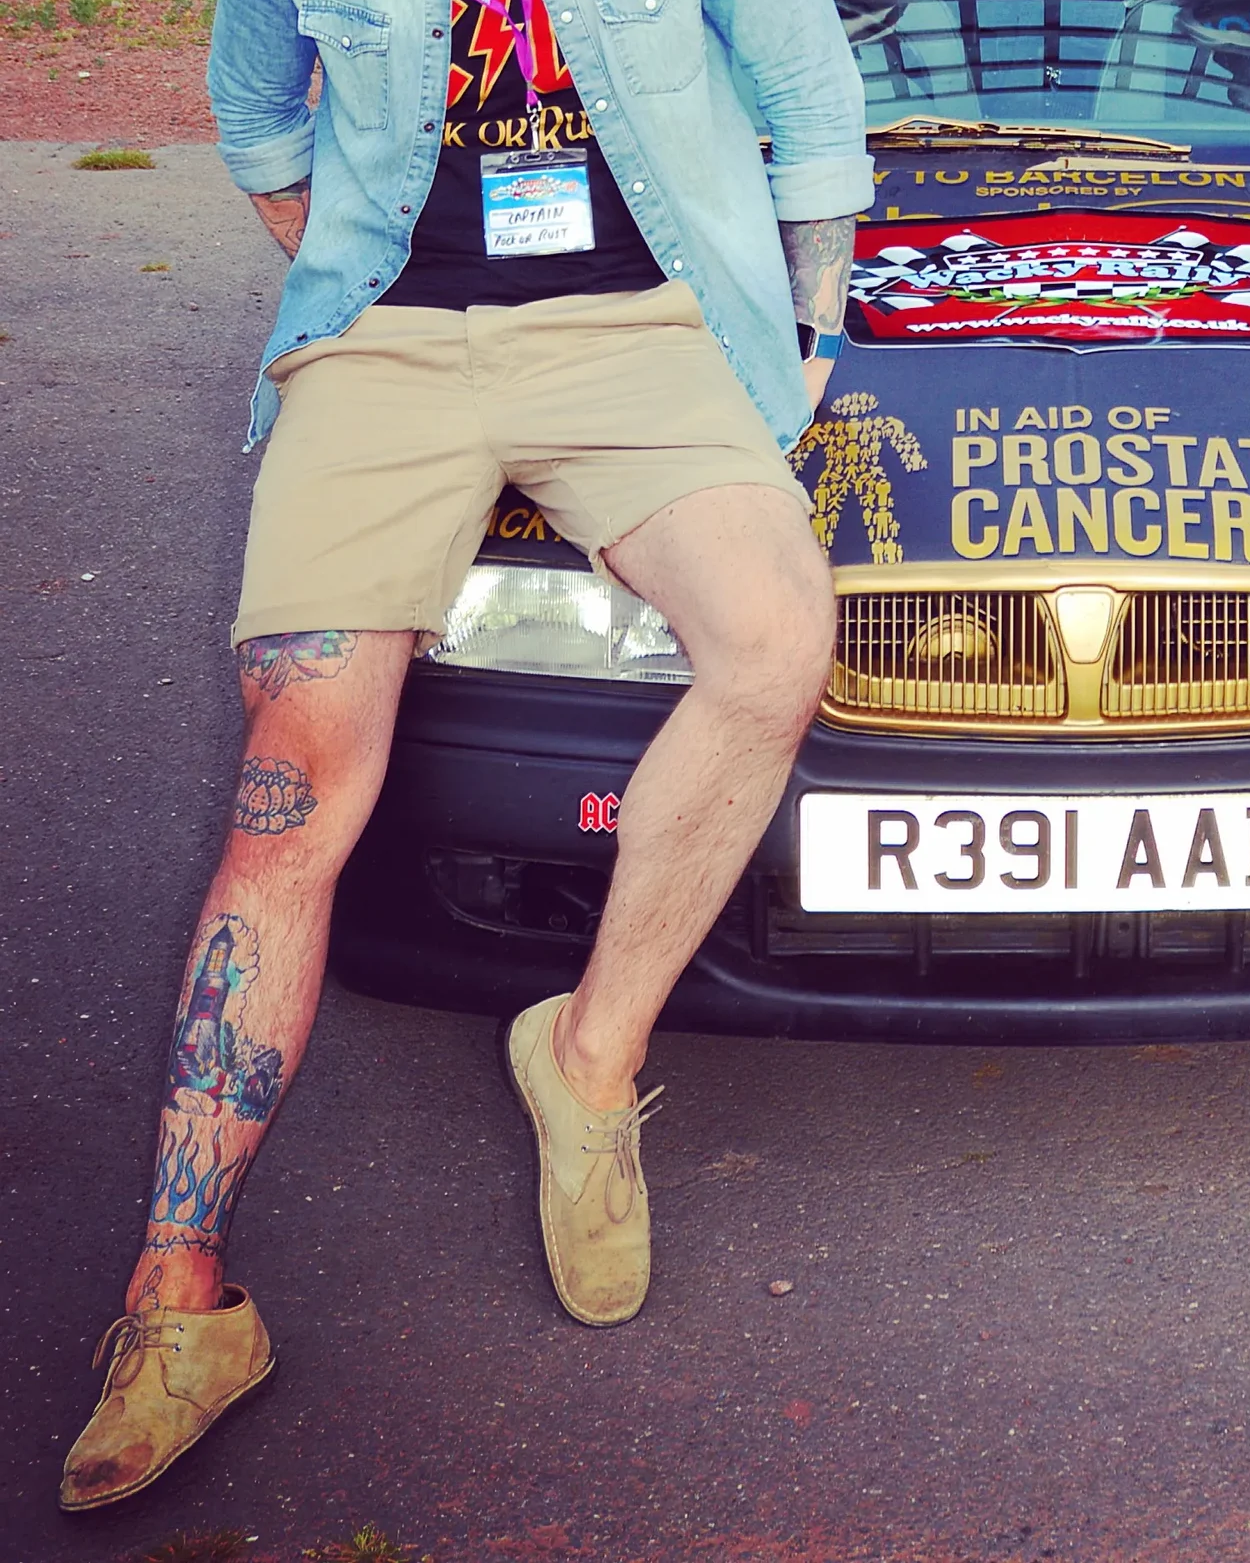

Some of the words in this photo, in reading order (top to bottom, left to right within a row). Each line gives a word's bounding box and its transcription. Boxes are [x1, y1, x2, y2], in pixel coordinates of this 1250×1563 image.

[975, 185, 1108, 198] SPONSORED
[1115, 187, 1143, 197] BY
[900, 261, 1081, 288] Wacky
[956, 406, 1000, 432] IN
[1014, 404, 1094, 430] AID
[1107, 406, 1171, 431] OF
[867, 809, 1078, 890] R391
